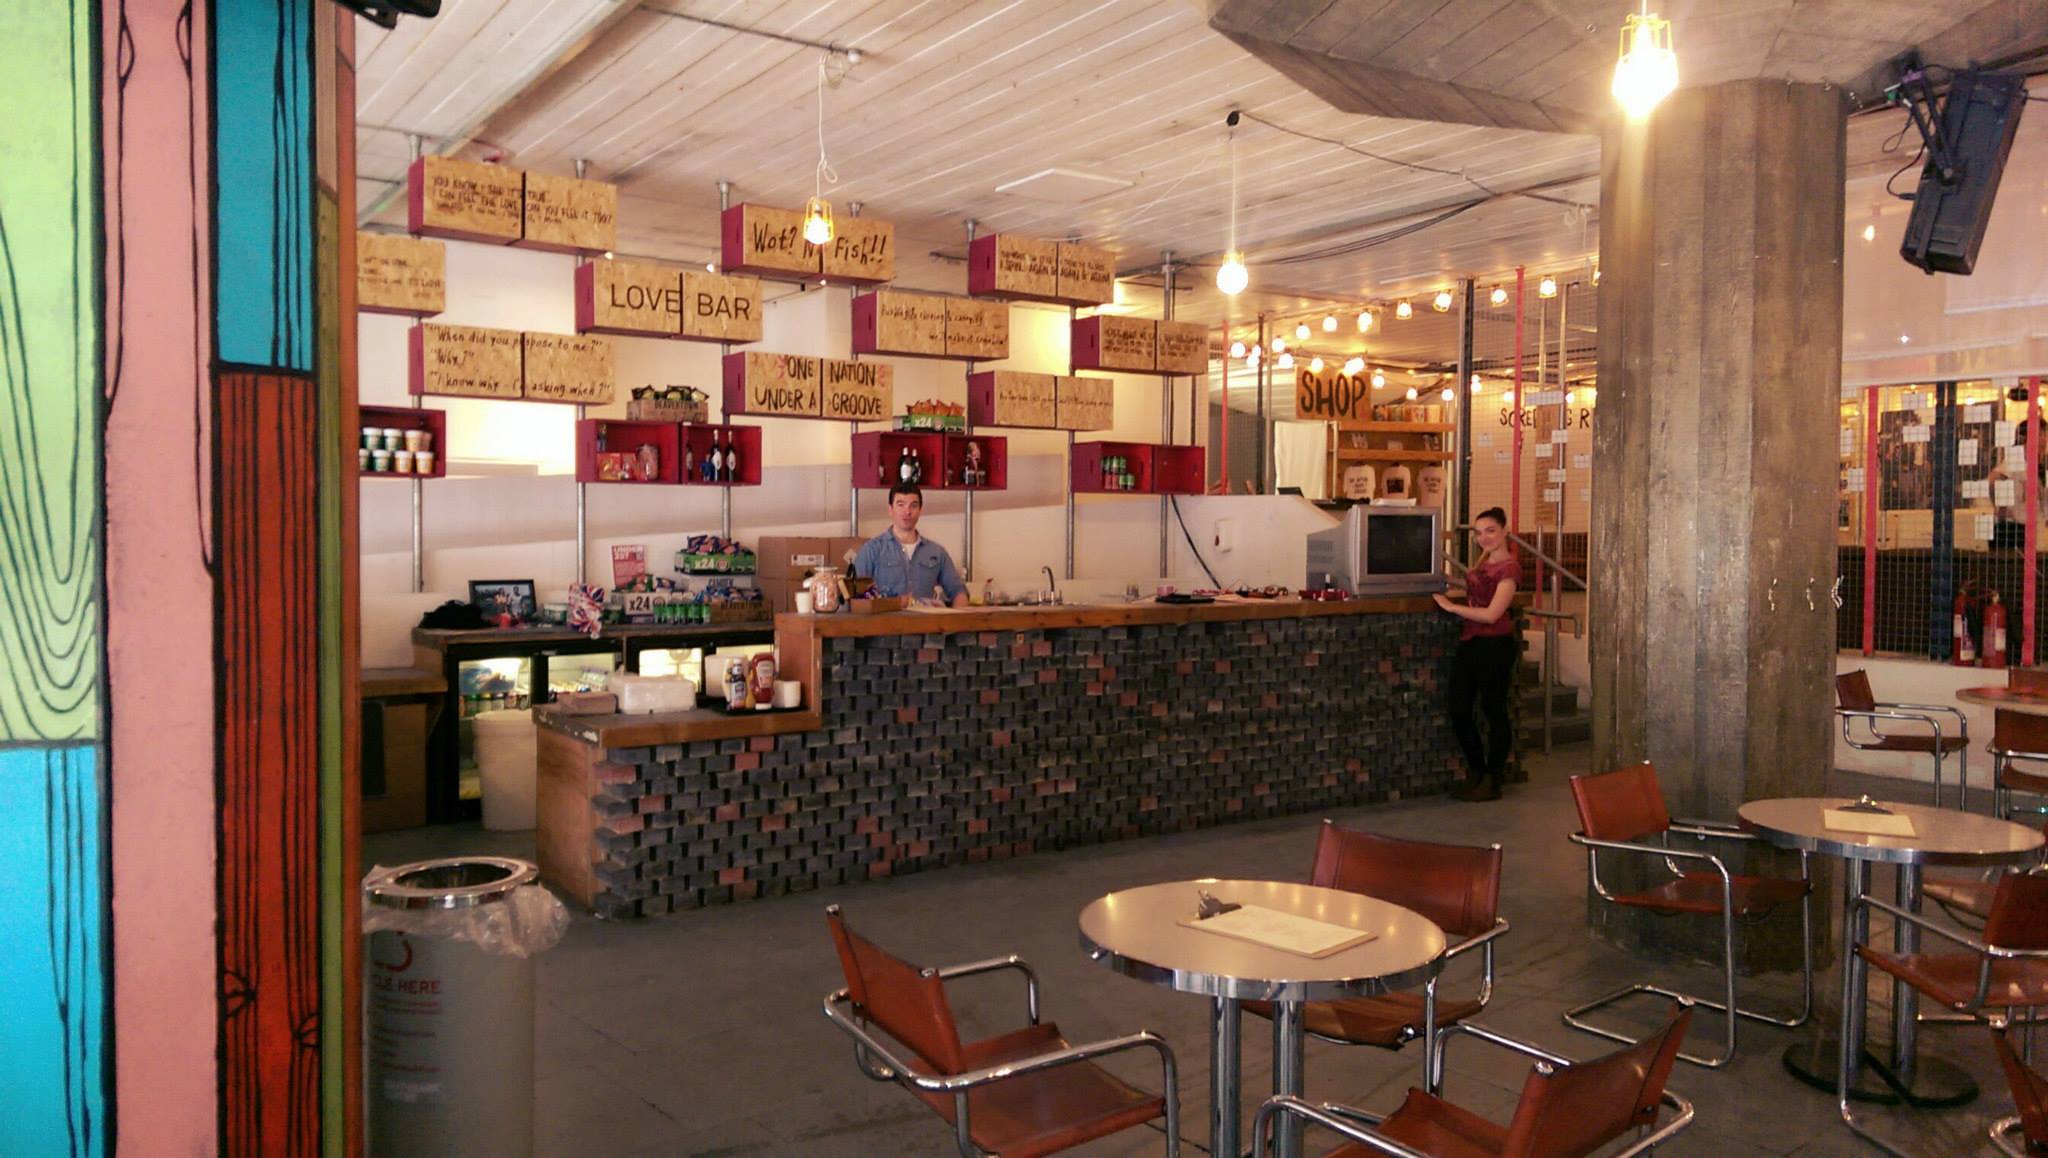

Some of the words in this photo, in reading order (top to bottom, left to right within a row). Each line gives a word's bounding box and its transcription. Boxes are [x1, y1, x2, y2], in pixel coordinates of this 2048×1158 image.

[753, 222, 799, 255] Wot?
[834, 234, 887, 265] Fish!!
[610, 283, 682, 314] LOVE
[696, 292, 751, 321] BAR
[469, 331, 486, 343] did
[490, 336, 509, 347] you
[557, 338, 569, 350] to
[446, 373, 474, 387] know
[479, 375, 499, 392] why
[532, 379, 566, 398] asking
[829, 361, 877, 387] NATION
[754, 386, 804, 411] UNDER
[808, 391, 817, 410] A
[831, 392, 882, 415] GROOVE
[1300, 369, 1367, 420] SHOP
[694, 558, 715, 570] x24
[629, 595, 651, 612] x24
[398, 980, 441, 995] HERE
